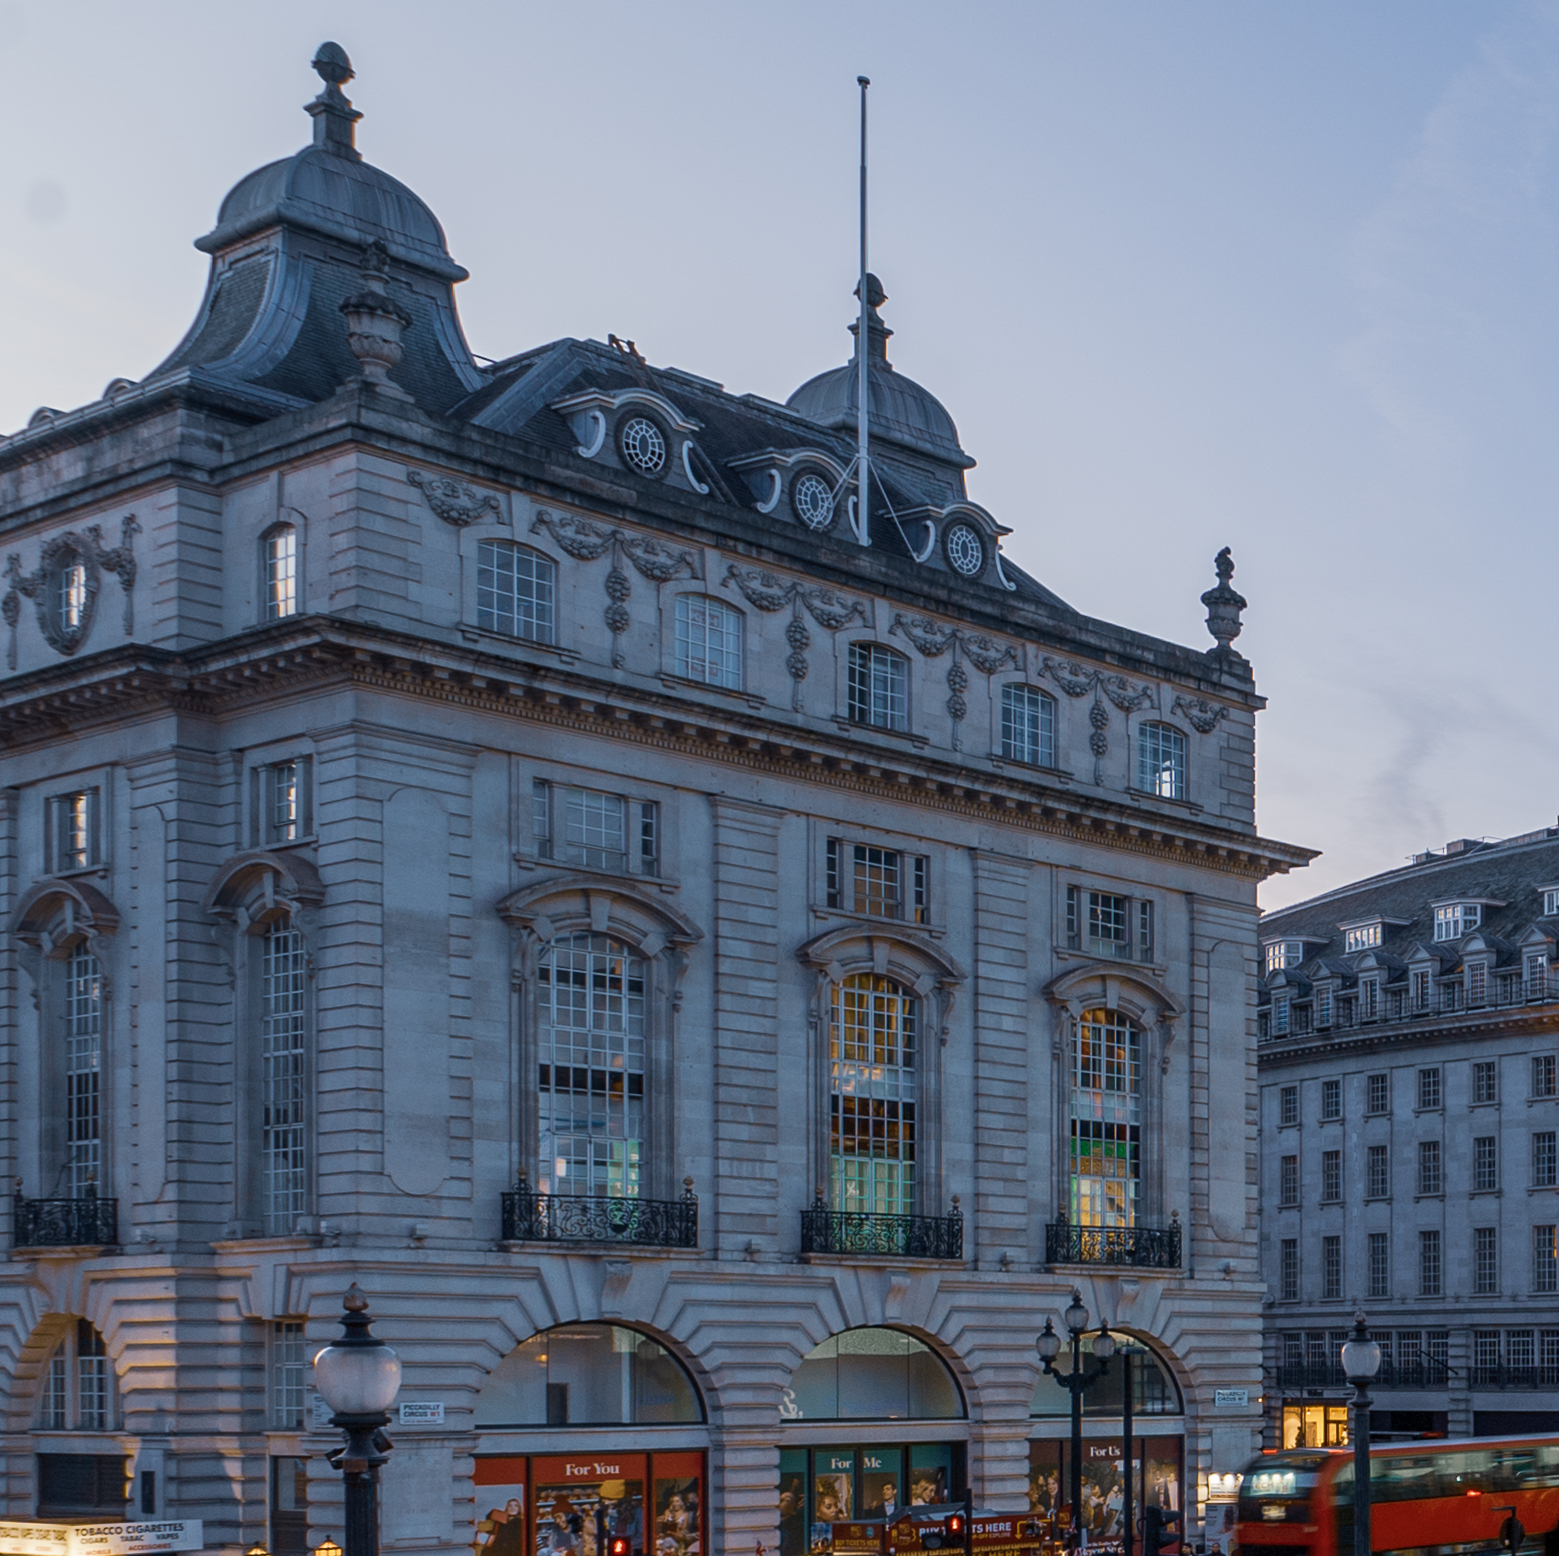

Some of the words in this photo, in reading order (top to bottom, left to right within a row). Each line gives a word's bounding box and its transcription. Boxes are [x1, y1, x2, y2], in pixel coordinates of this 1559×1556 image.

[1090, 1447, 1105, 1457] For
[1106, 1446, 1121, 1457] Us
[565, 1463, 591, 1477] For
[594, 1461, 620, 1475] You
[831, 1458, 852, 1470] For
[864, 1457, 882, 1469] Me
[75, 1526, 123, 1537] TOBACCO
[126, 1523, 185, 1534] CIGARETTES
[987, 1522, 1012, 1532] HERE
[80, 1537, 109, 1545] CIGARS
[120, 1535, 144, 1543] TABAC
[156, 1533, 179, 1541] VAPES
[835, 1539, 844, 1547] BUY
